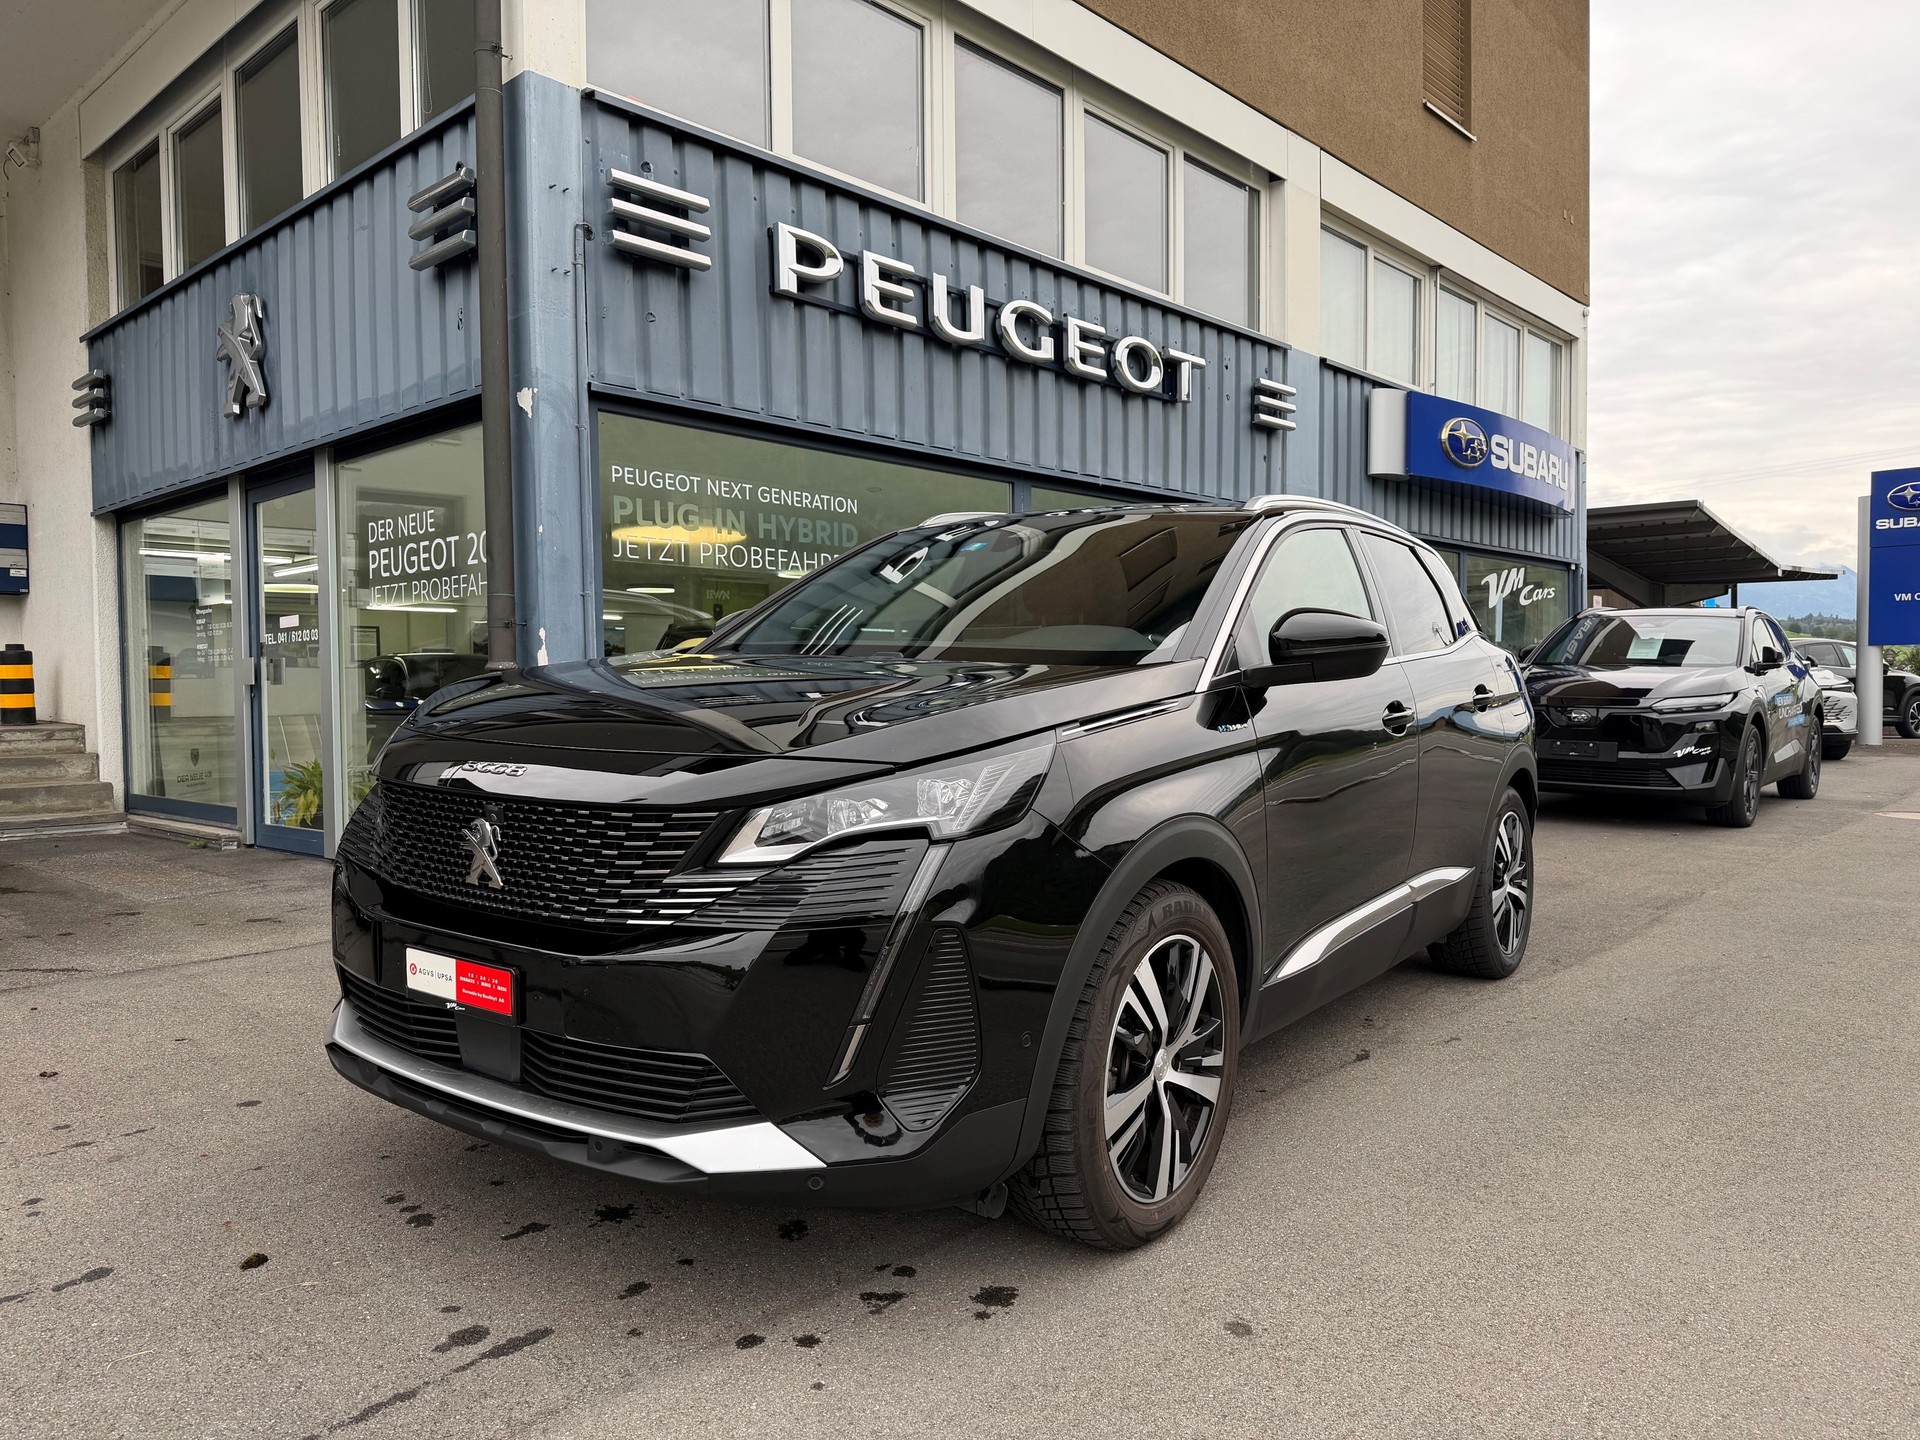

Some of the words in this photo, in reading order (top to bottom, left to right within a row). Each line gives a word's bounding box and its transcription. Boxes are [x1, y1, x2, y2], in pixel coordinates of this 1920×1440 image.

[769, 222, 1207, 404] PEUGEOT
[1490, 434, 1568, 491] SUBARU
[611, 465, 701, 494] PEUGEOT
[707, 478, 753, 501] NEXT
[758, 486, 858, 514] GENERATION
[368, 518, 394, 543] DER
[398, 510, 436, 538] NEUE
[613, 495, 746, 537] PLUG-IN
[758, 512, 859, 548] HYBRID
[1875, 516, 1920, 530] SUB
[369, 535, 460, 580] PEUGEOT
[613, 535, 690, 563] JETZT
[1481, 567, 1525, 609] VM
[1519, 585, 1556, 606] Cars
[1894, 593, 1912, 602] VM
[278, 632, 288, 644] 041
[291, 630, 303, 643] 612
[303, 629, 311, 642] 03
[310, 628, 319, 641] 03
